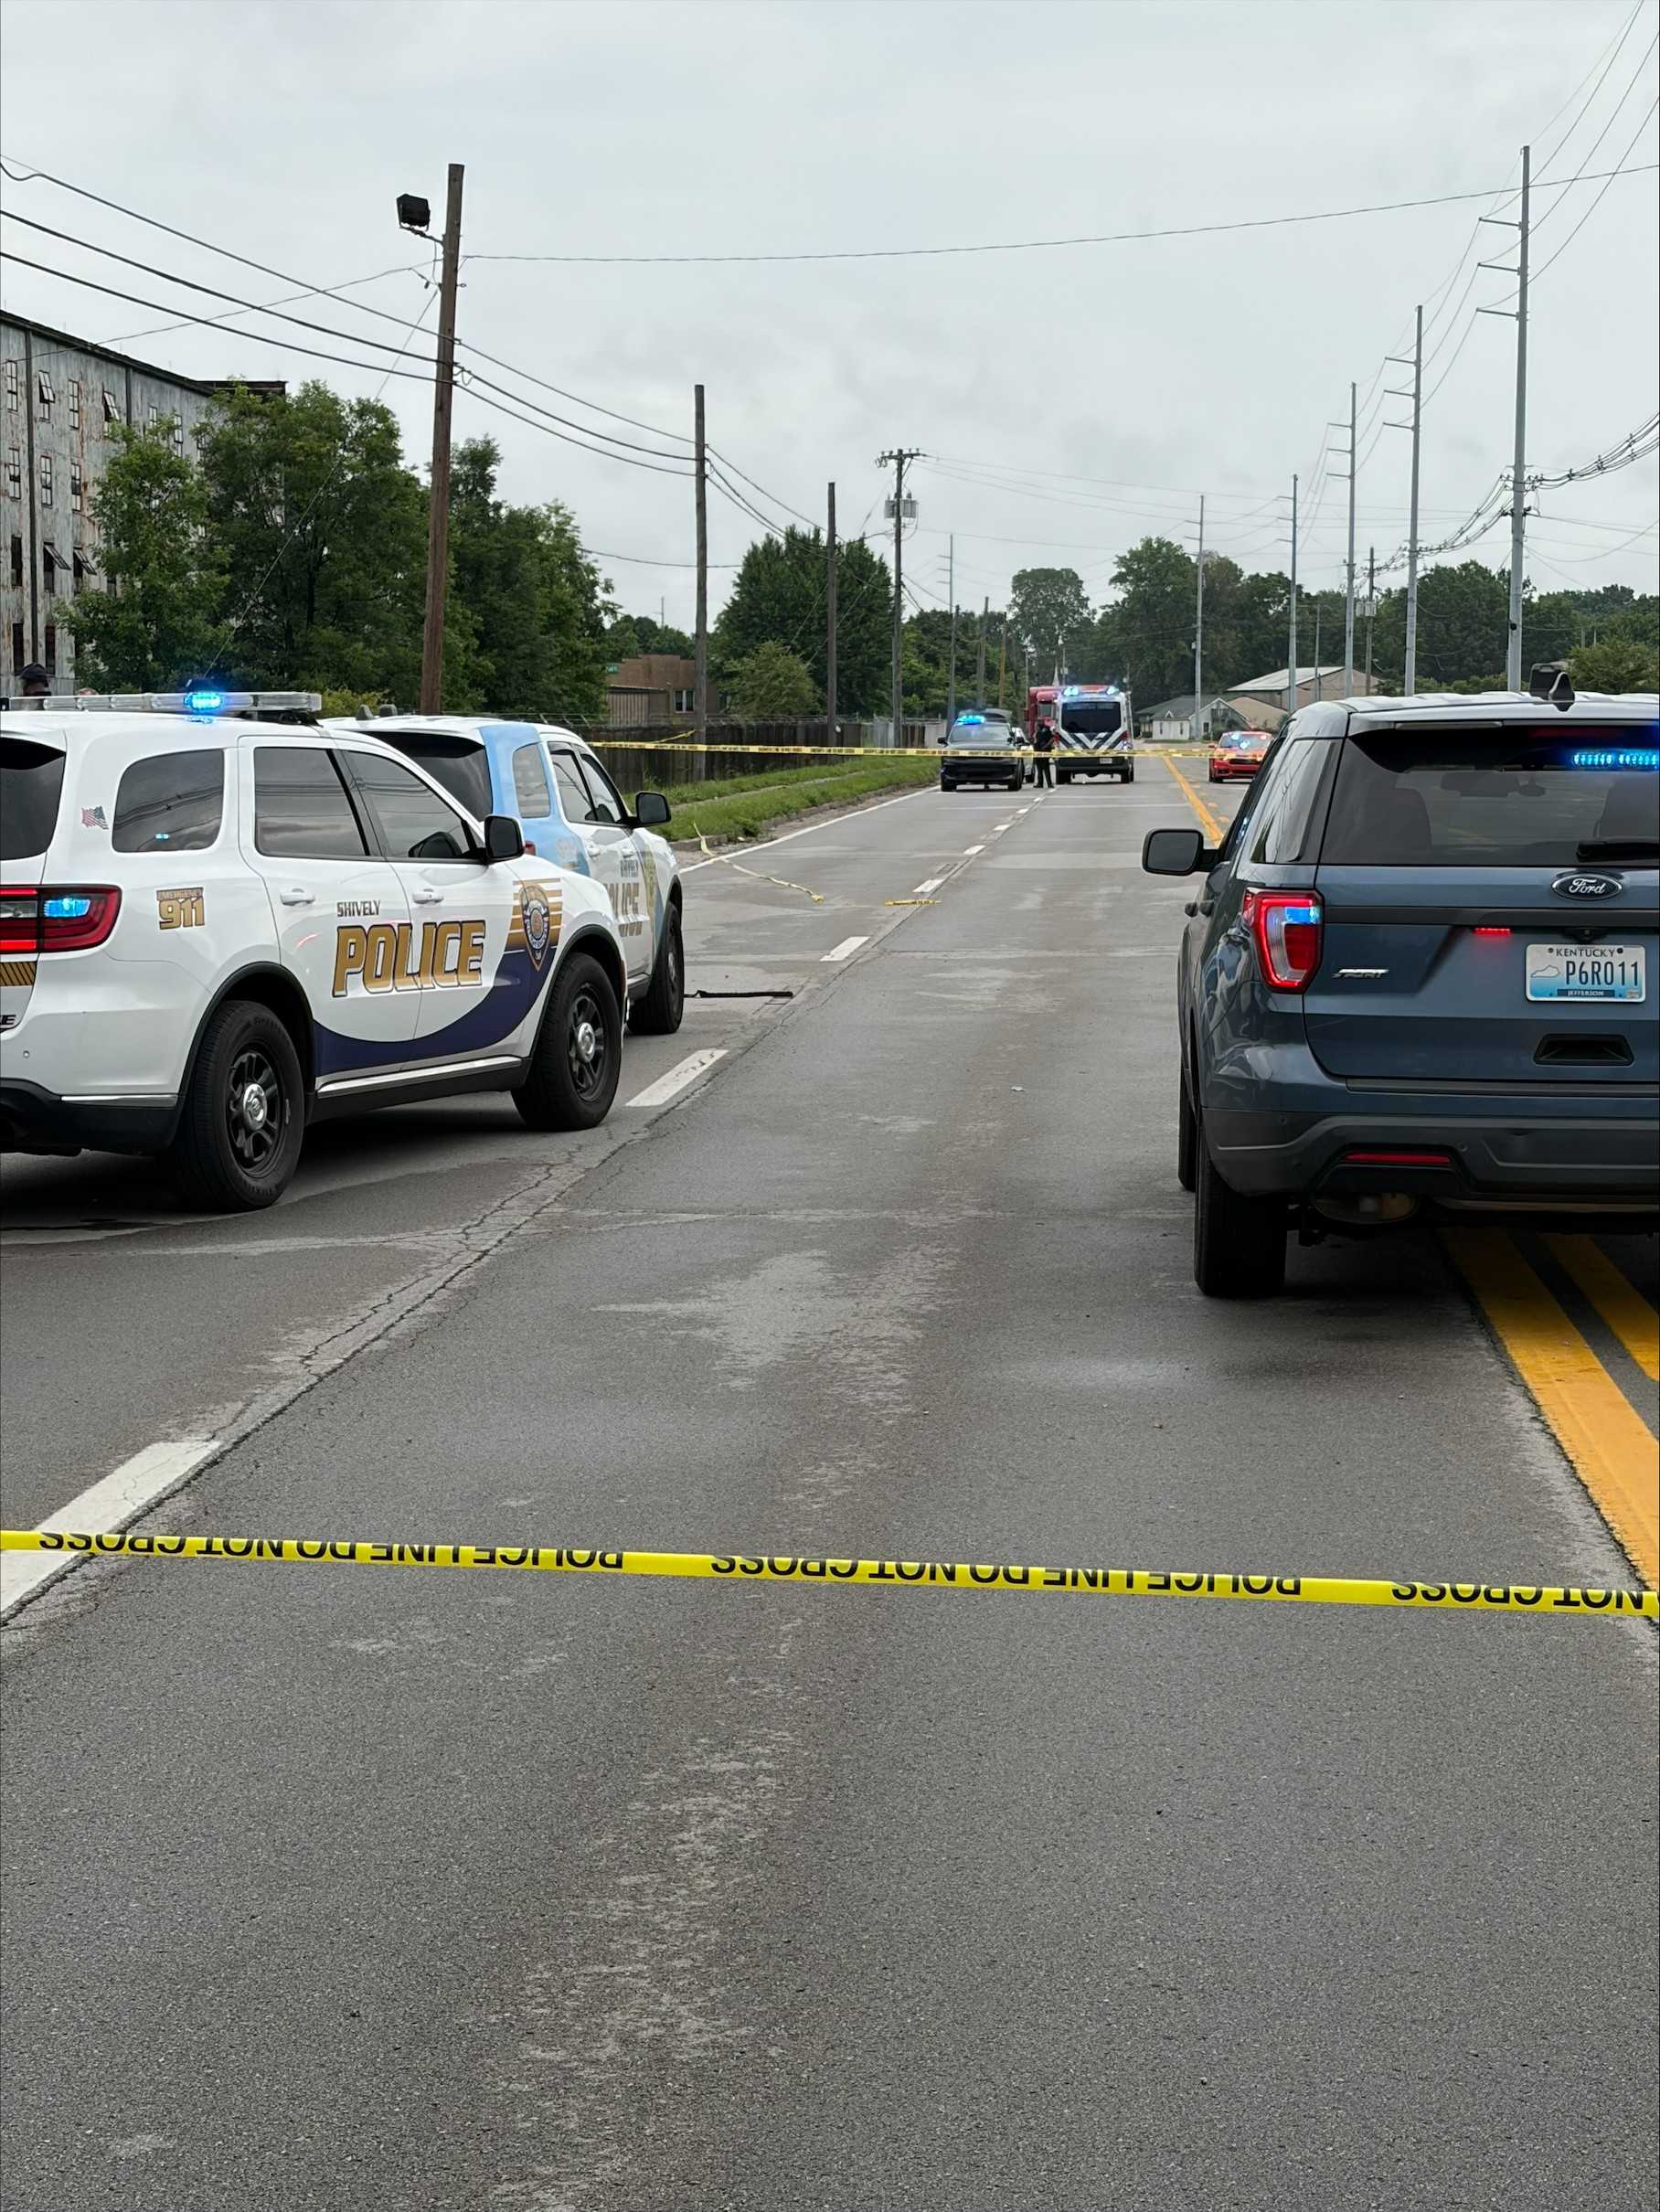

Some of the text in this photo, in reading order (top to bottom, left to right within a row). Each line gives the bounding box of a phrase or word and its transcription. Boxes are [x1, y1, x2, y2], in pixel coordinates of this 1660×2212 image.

[1569, 878, 1606, 894] Ford
[159, 897, 205, 930] 911
[336, 899, 381, 917] SHIVELY
[332, 920, 486, 997] POLICE
[1556, 948, 1615, 957] KENTUCKY
[1565, 961, 1639, 986] P6R011
[196, 1537, 283, 1558] NOT
[296, 1541, 356, 1559] DO
[868, 1560, 956, 1581] NOT
[970, 1564, 1029, 1584] DO
[1553, 1587, 1644, 1610] NOT
